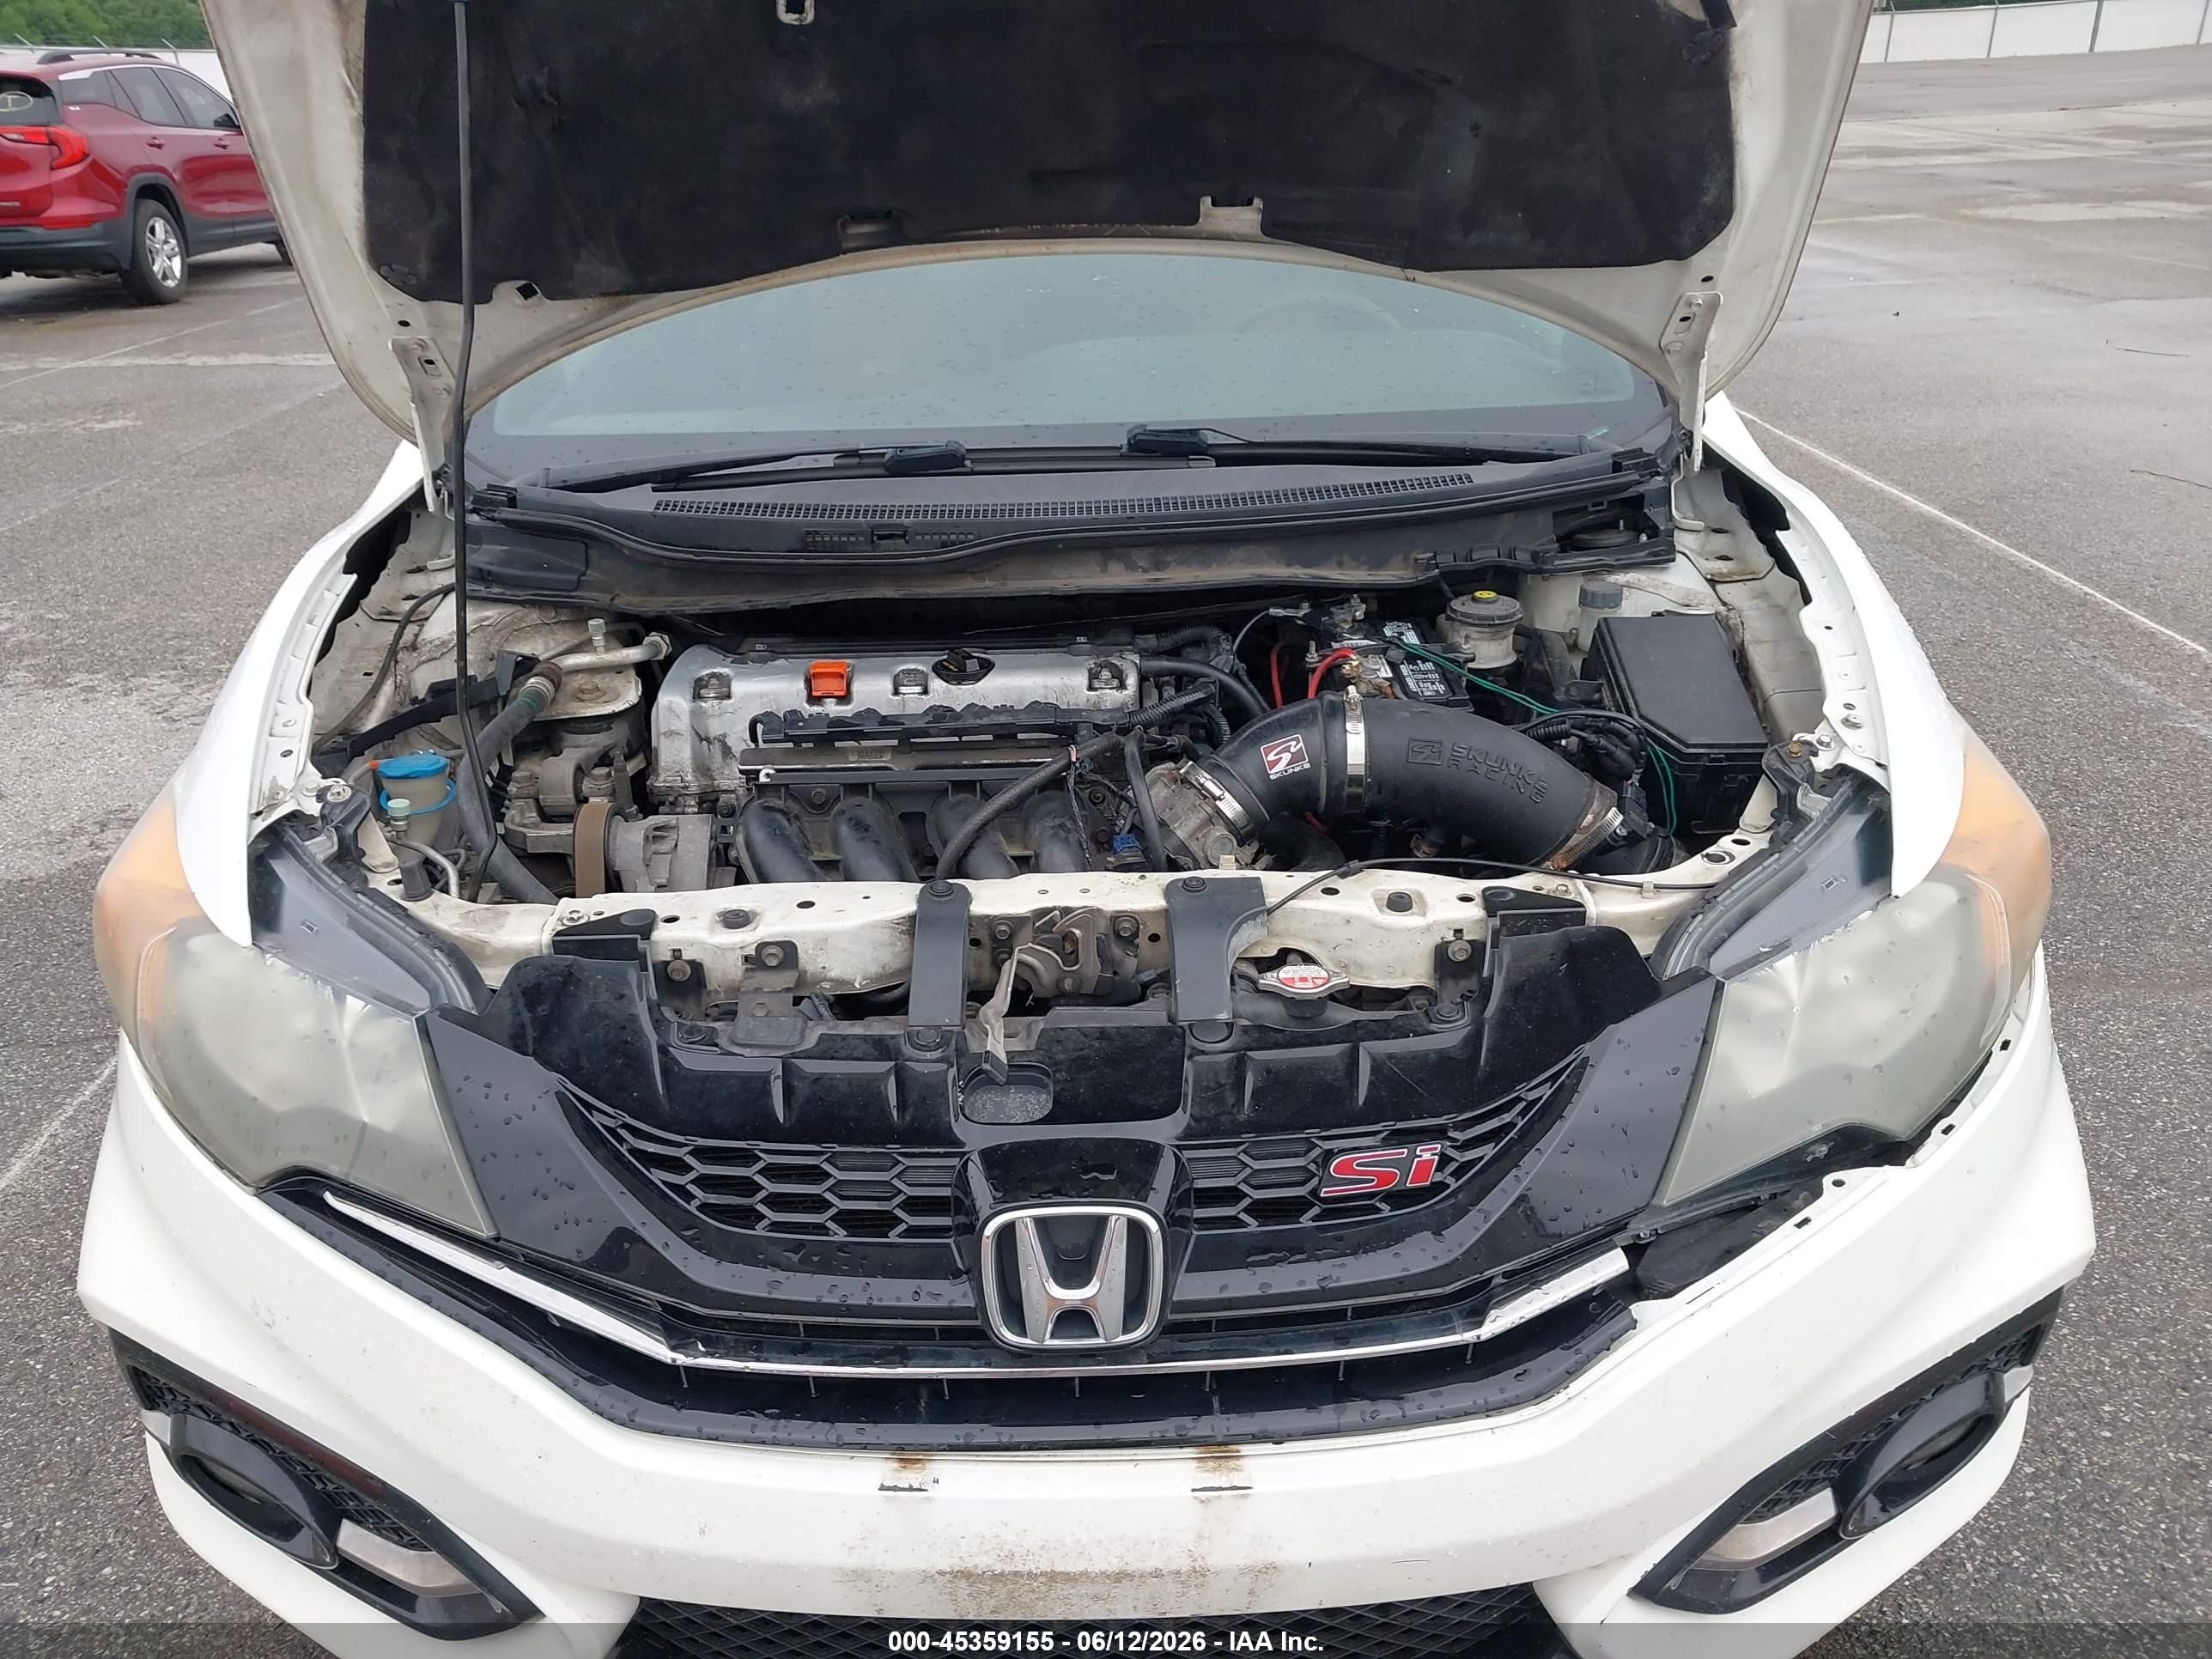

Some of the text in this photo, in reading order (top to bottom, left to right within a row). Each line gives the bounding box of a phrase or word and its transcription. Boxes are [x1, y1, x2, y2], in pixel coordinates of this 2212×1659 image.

[1269, 763, 1311, 780] SKUNK2
[1447, 757, 1547, 805] RACING
[1450, 742, 1549, 795] SKUNK2
[1320, 1144, 1441, 1197] Si
